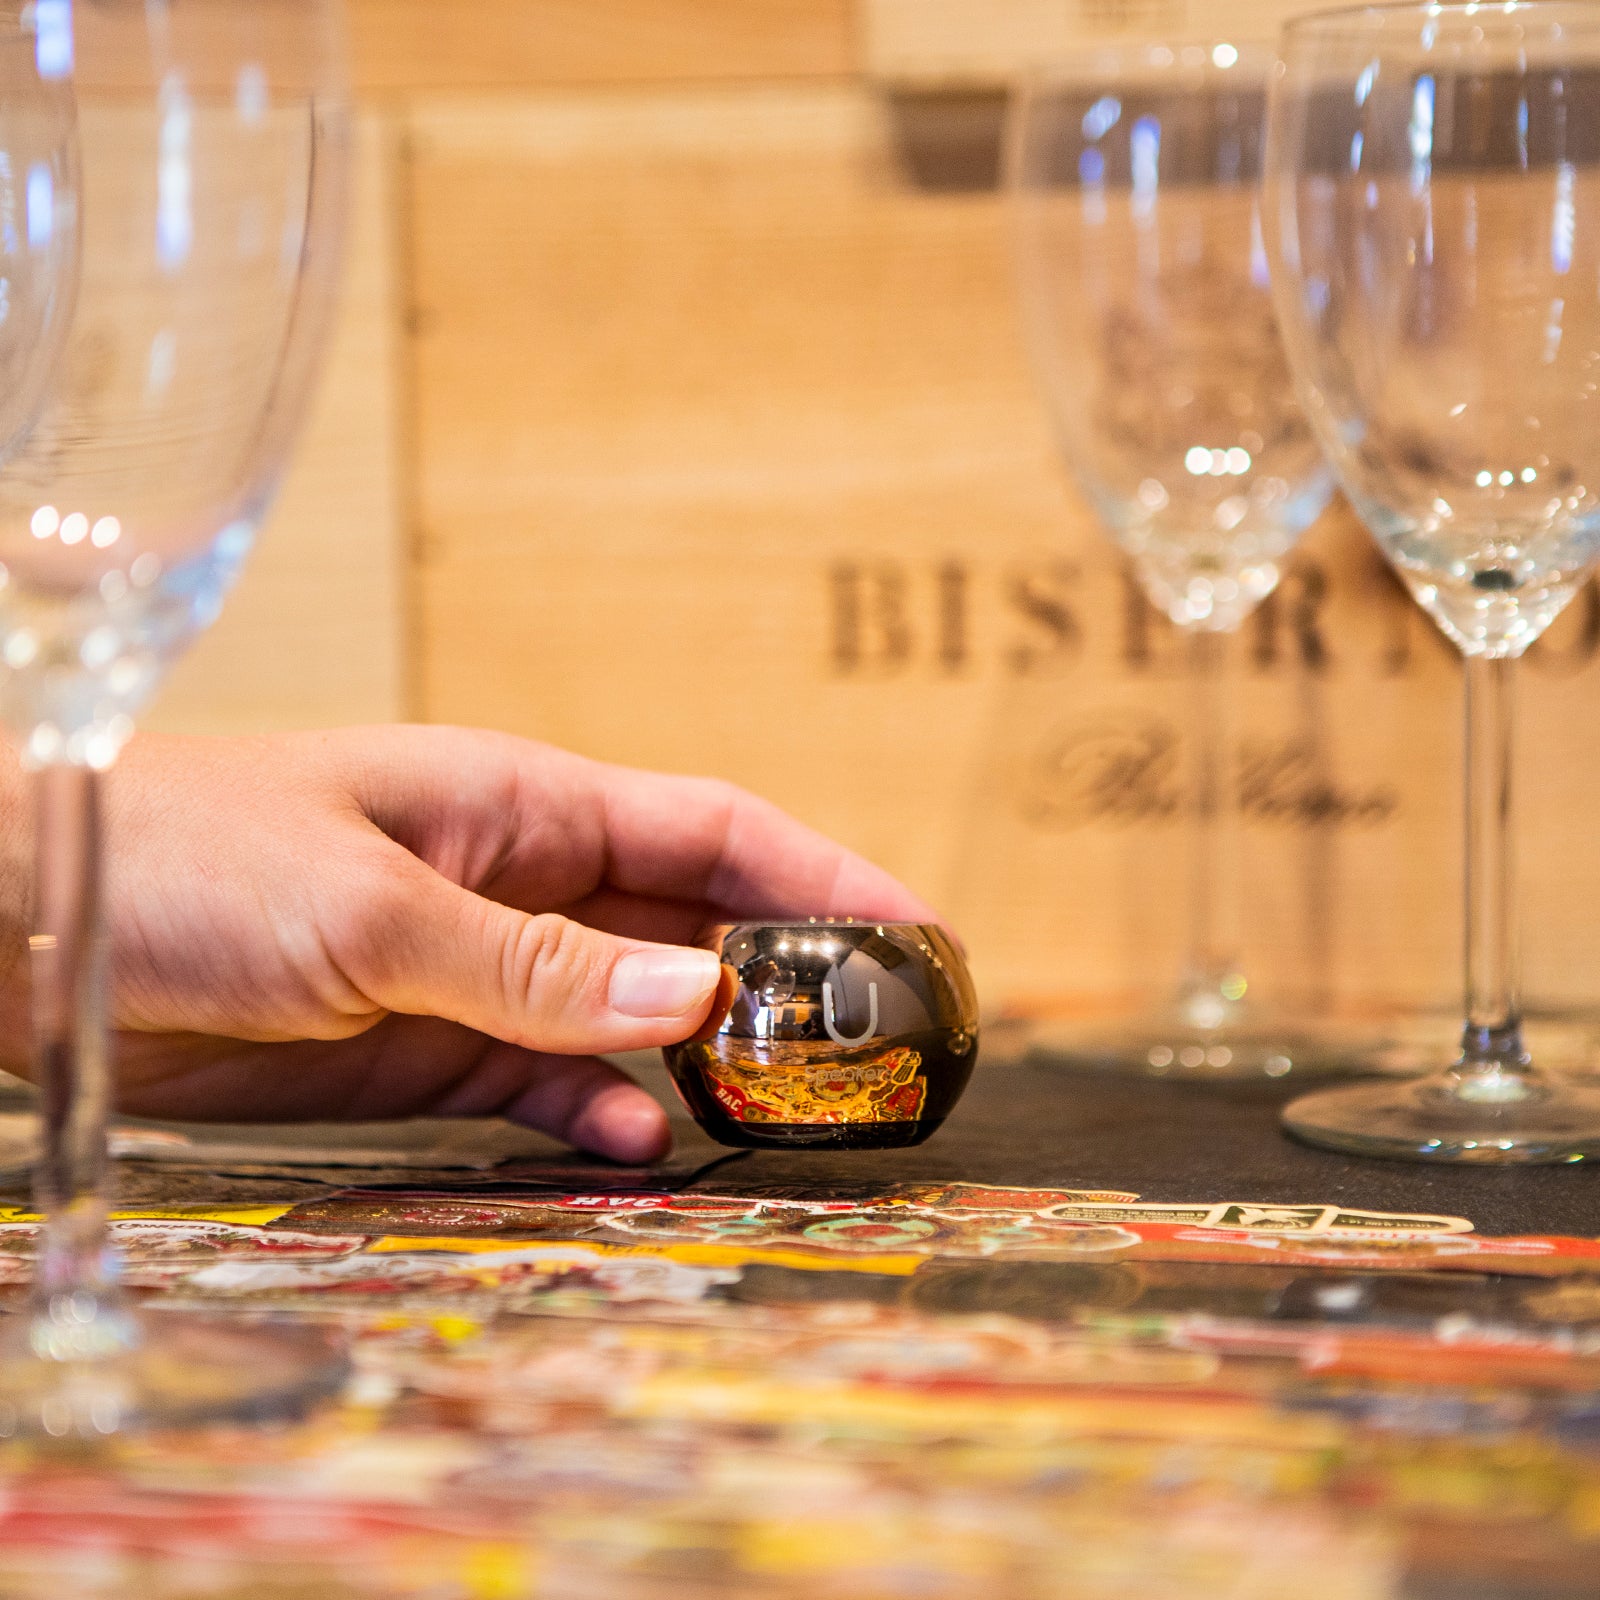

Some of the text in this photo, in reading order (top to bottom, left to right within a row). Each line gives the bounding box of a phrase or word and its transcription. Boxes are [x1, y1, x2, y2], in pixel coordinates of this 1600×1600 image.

[822, 982, 878, 1047] U
[804, 1065, 893, 1088] Speakers
[566, 1196, 663, 1207] HVC
